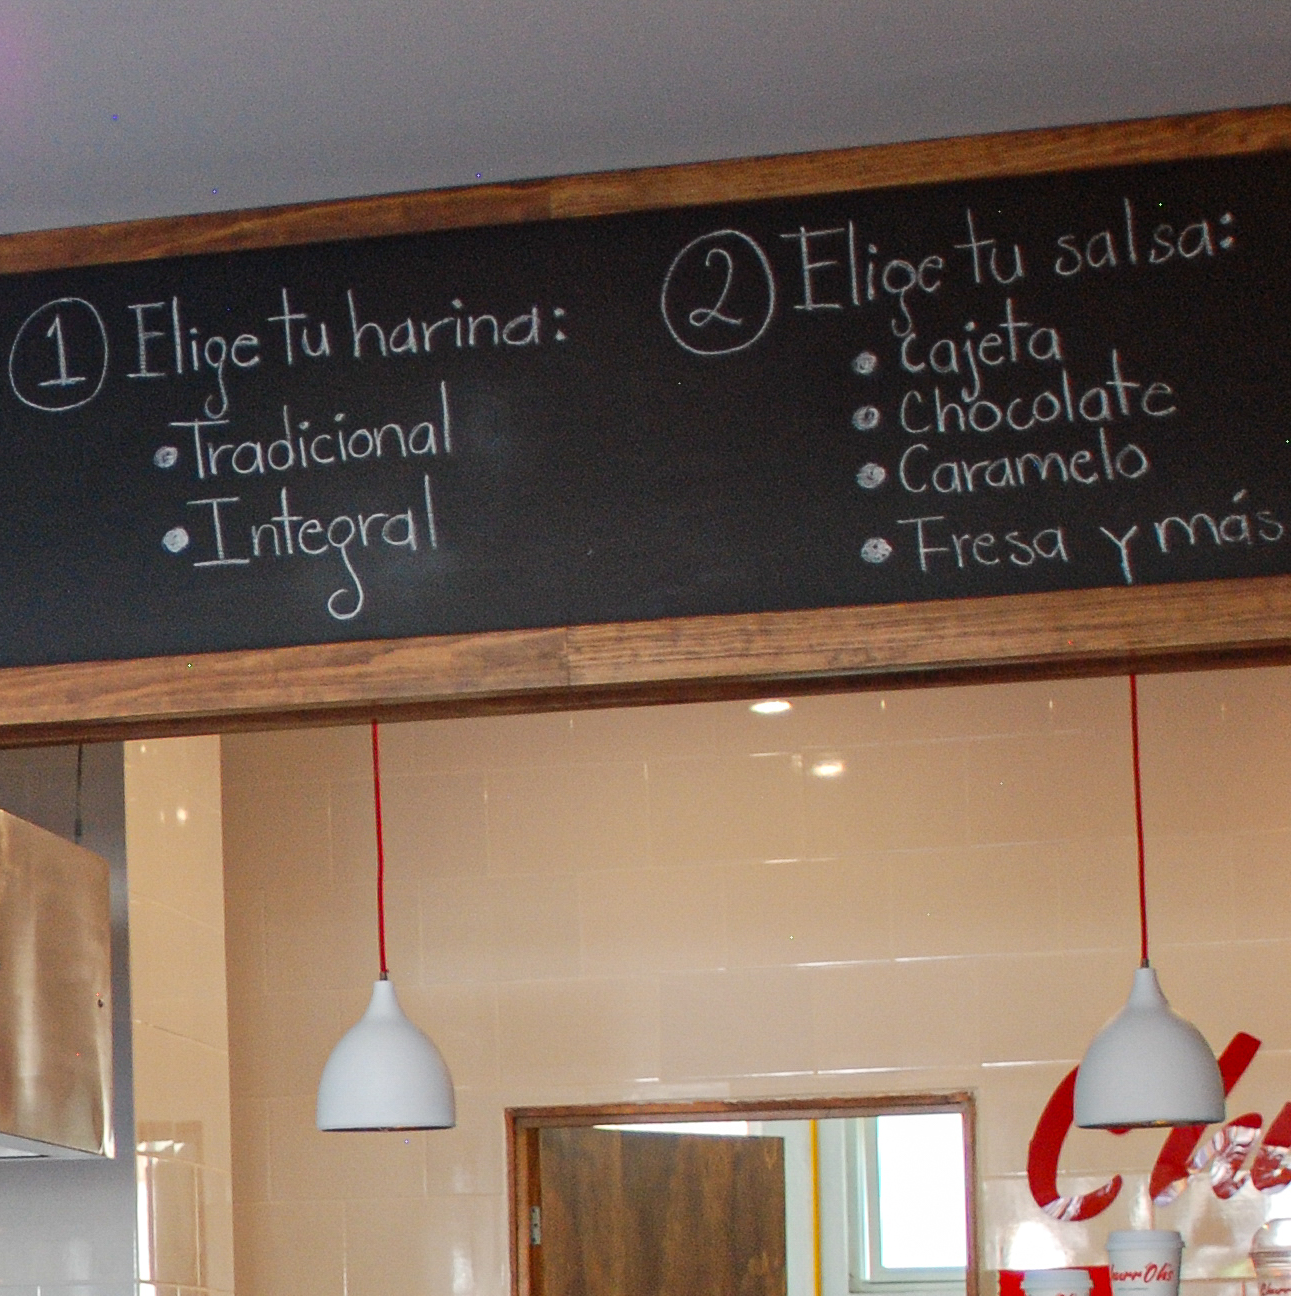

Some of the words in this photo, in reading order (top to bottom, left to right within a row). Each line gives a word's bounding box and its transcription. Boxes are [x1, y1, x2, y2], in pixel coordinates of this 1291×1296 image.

[689, 249, 743, 327] 2
[780, 220, 944, 338] Elige
[955, 209, 1024, 285] tu
[1056, 199, 1236, 277] salsa:
[38, 313, 87, 388] 1
[126, 296, 262, 418] Elige
[267, 287, 331, 365] tu
[346, 289, 568, 359] harina:
[900, 298, 1063, 402] Cajeta
[900, 349, 1176, 435] Chocolate
[169, 380, 453, 479] Tradicional
[899, 428, 1150, 494] Caramelo
[186, 474, 437, 621] Integral
[897, 515, 1071, 572] Fresa
[1154, 489, 1286, 554] más
